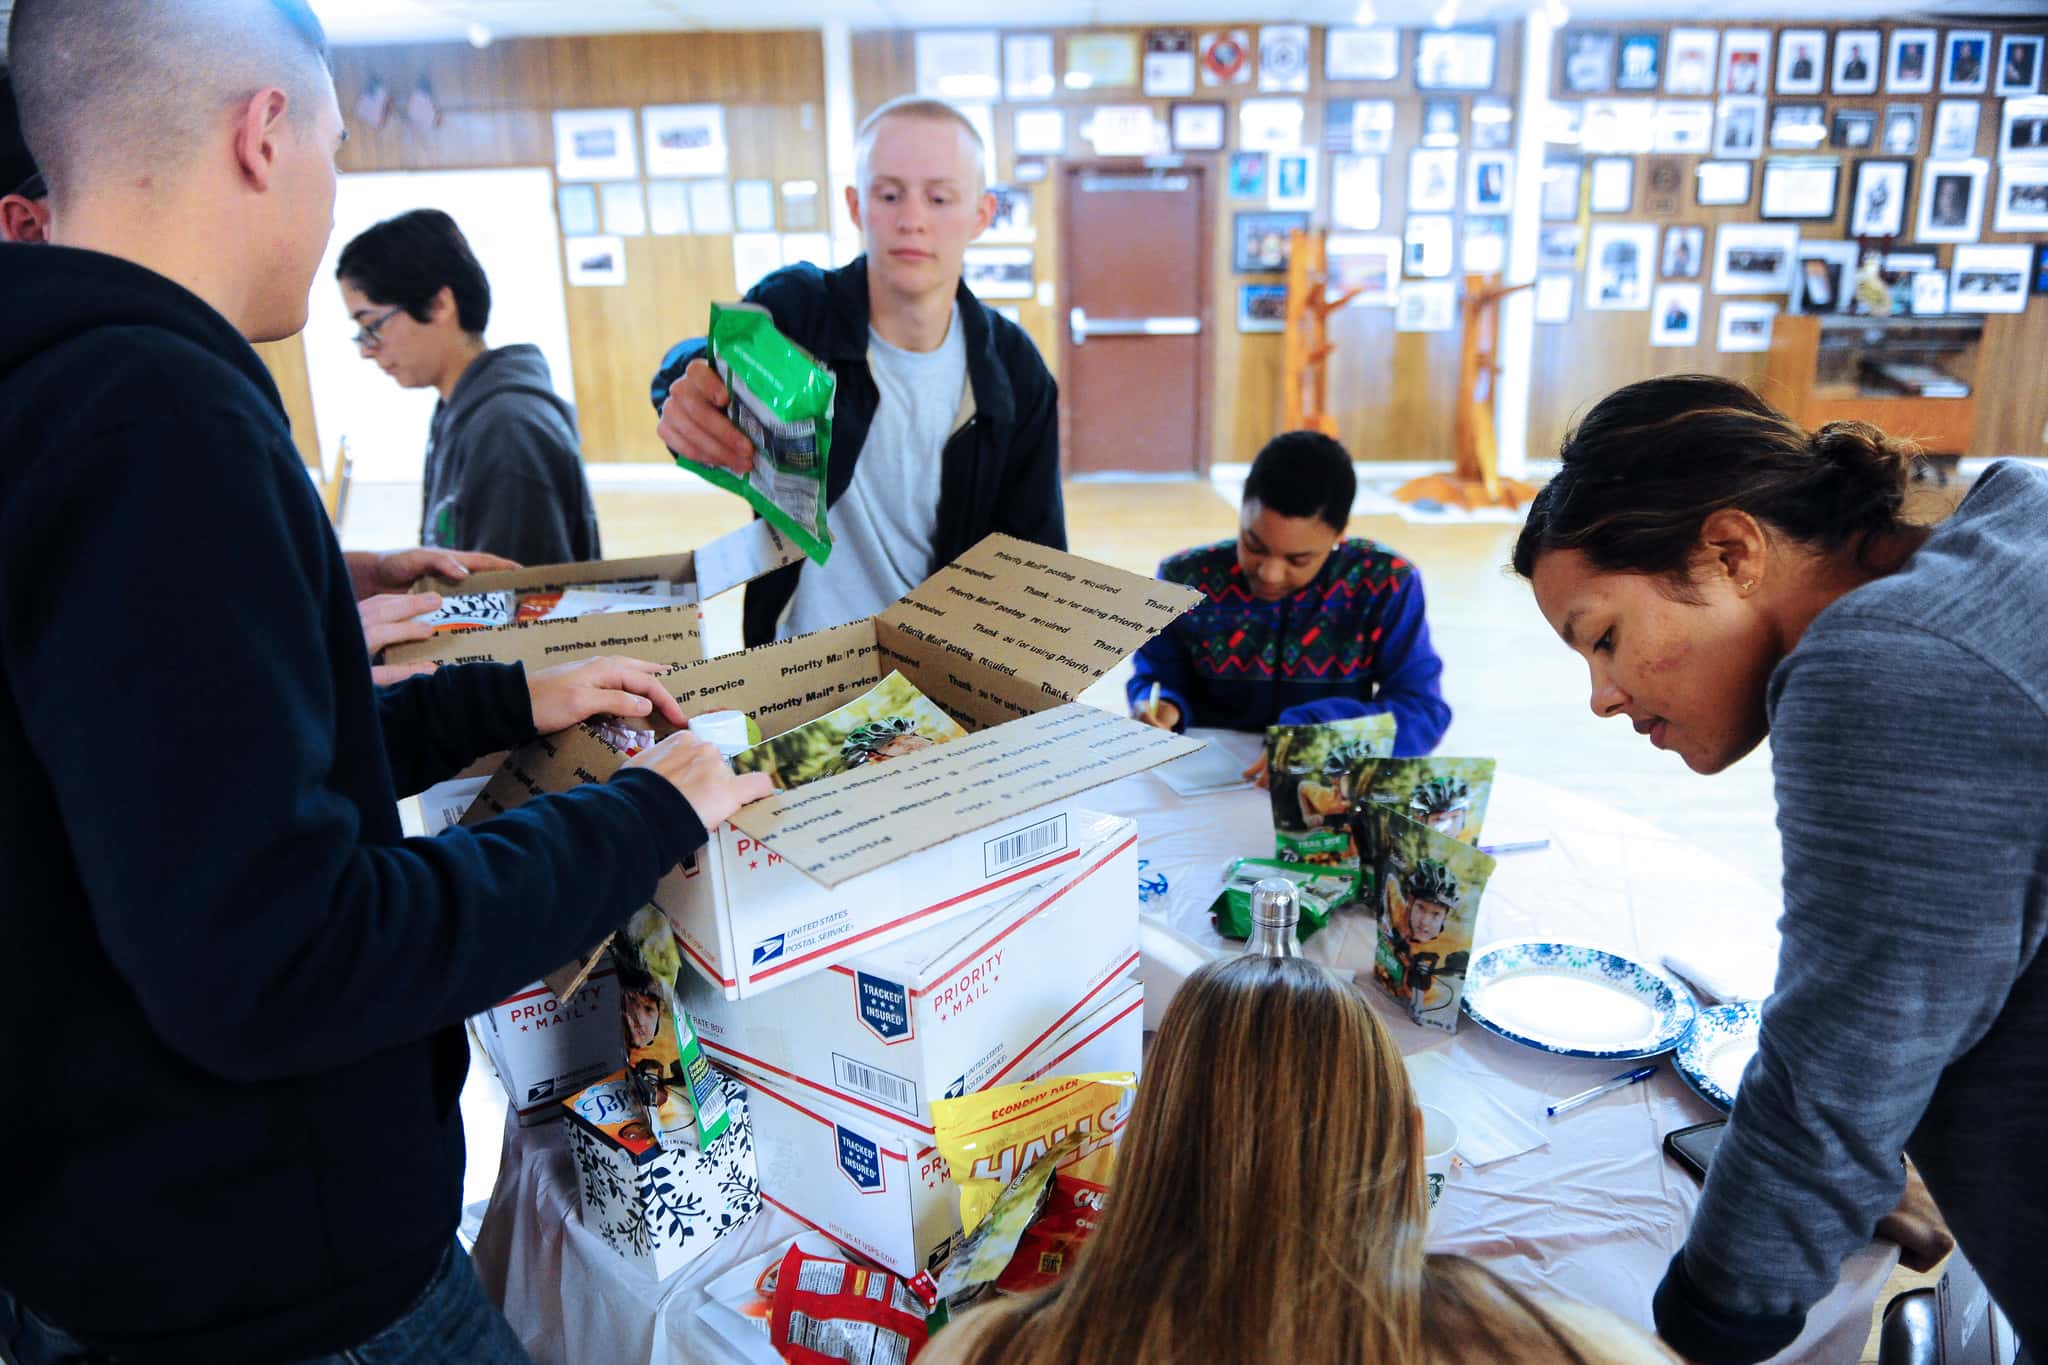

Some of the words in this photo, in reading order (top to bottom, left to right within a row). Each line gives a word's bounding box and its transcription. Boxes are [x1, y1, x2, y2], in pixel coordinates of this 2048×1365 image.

[1024, 585, 1050, 600] Thank
[1144, 598, 1176, 615] Thank
[898, 622, 925, 641] Priority
[972, 623, 1000, 638] Thank
[544, 640, 598, 656] required
[599, 634, 649, 649] postage
[1093, 639, 1124, 655] Thank
[781, 659, 823, 677] Priority
[699, 679, 745, 697] Service
[1040, 681, 1069, 702] Thank
[760, 696, 802, 716] Priority
[786, 920, 819, 939] UNITED
[819, 909, 849, 927] STATES
[785, 936, 817, 954] POSTAL
[934, 949, 1003, 1013] PRIORITY
[953, 984, 989, 1017] MAIL
[536, 1008, 584, 1030] MAIL
[692, 1015, 709, 1028] RATE
[710, 1022, 725, 1034] BOX
[991, 1091, 1049, 1121] ECONOMY
